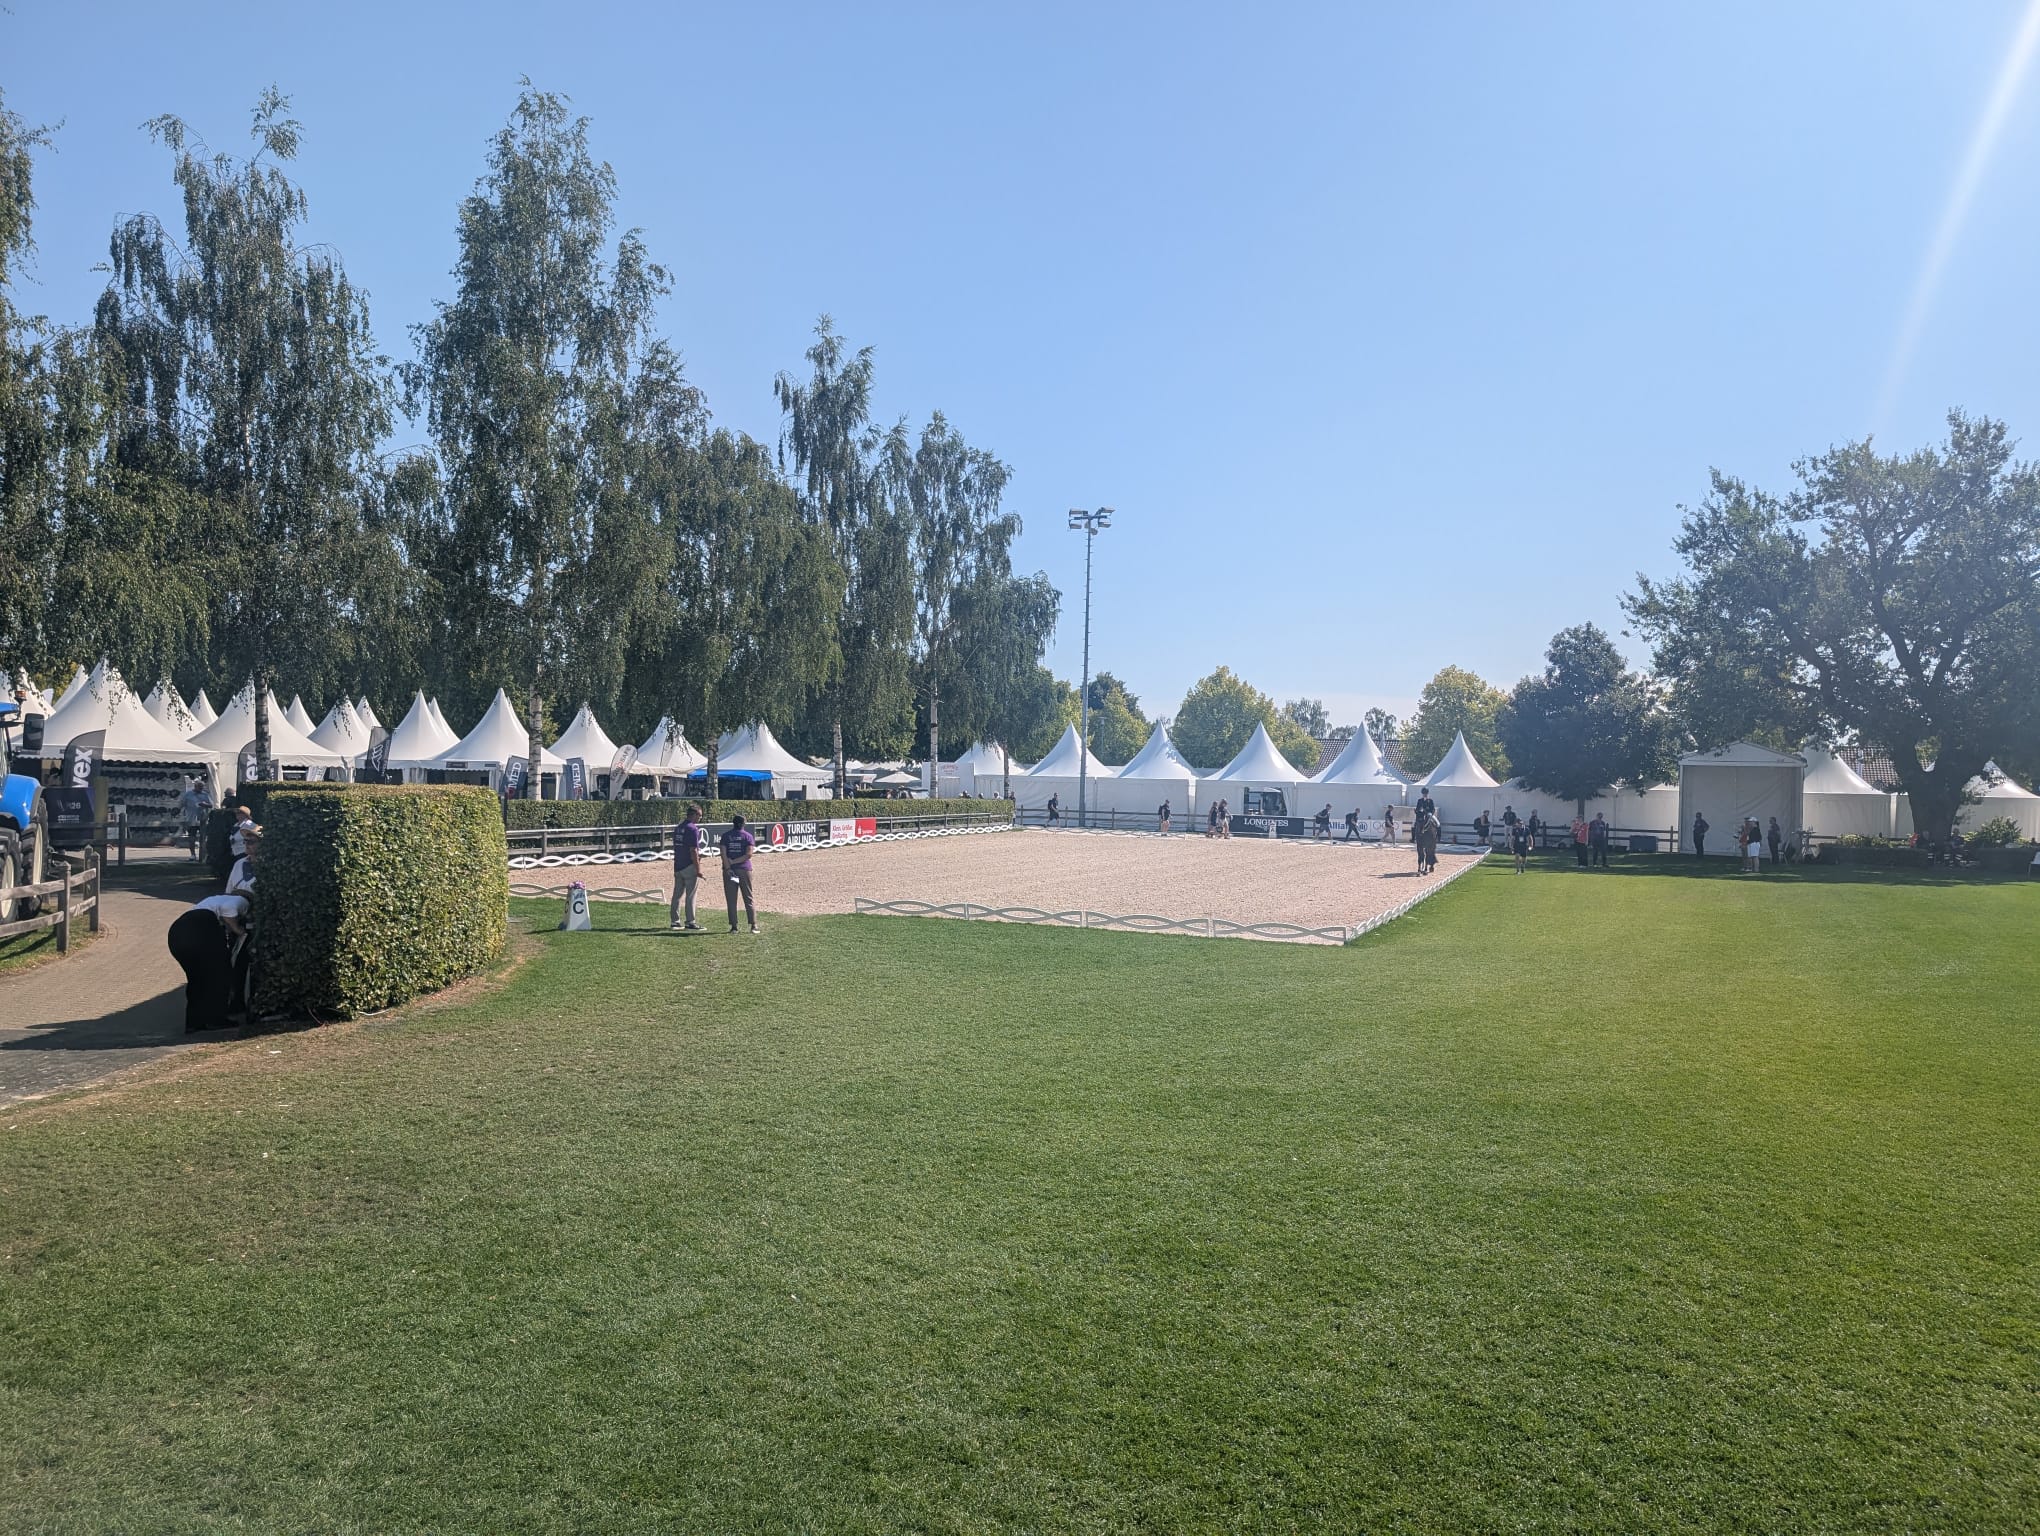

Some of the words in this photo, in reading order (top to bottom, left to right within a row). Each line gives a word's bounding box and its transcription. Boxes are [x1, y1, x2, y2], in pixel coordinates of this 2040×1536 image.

[1244, 818, 1288, 826] LONGES
[787, 822, 817, 835] TURKISH
[787, 834, 817, 846] AIRLINES
[573, 901, 584, 914] C
